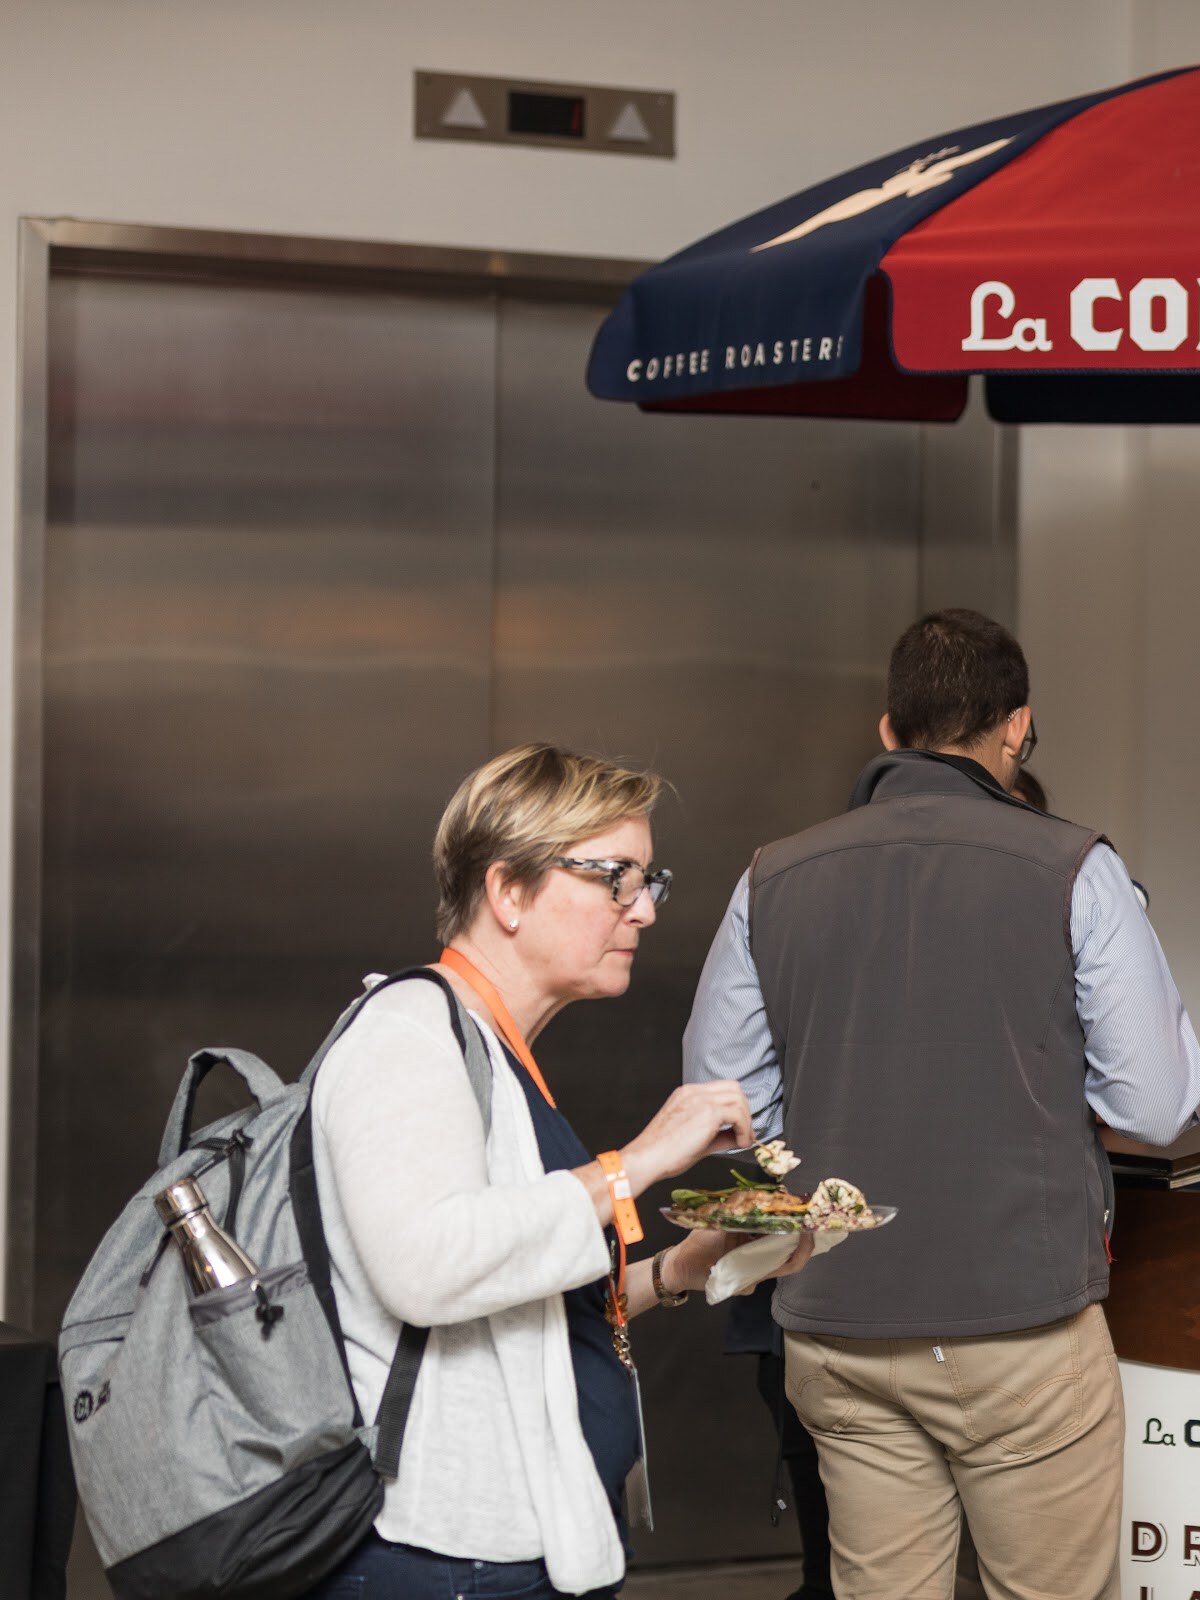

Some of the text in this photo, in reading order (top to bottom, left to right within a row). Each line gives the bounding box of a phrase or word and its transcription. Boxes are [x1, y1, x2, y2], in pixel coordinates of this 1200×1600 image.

[961, 280, 1053, 352] La
[626, 349, 710, 383] COFFEE
[1142, 1418, 1176, 1446] La
